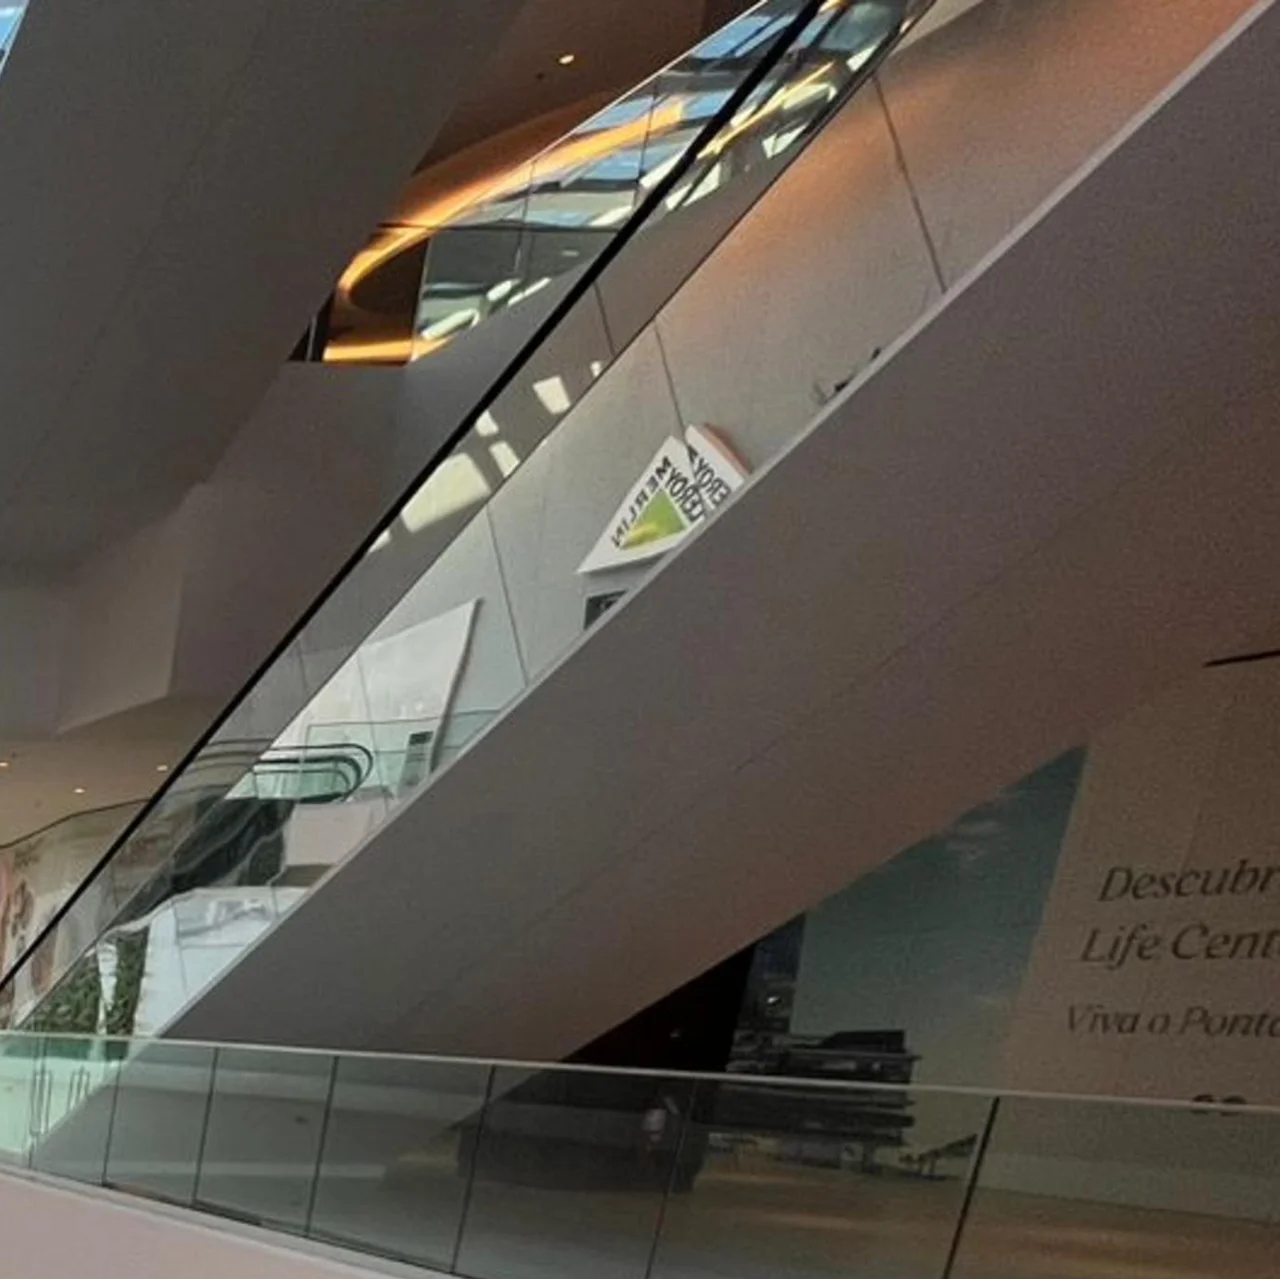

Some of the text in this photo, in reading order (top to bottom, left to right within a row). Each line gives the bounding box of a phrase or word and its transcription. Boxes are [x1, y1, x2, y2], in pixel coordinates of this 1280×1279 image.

[1080, 923, 1280, 970] Life Cent
[1068, 1004, 1141, 1034] Viva
